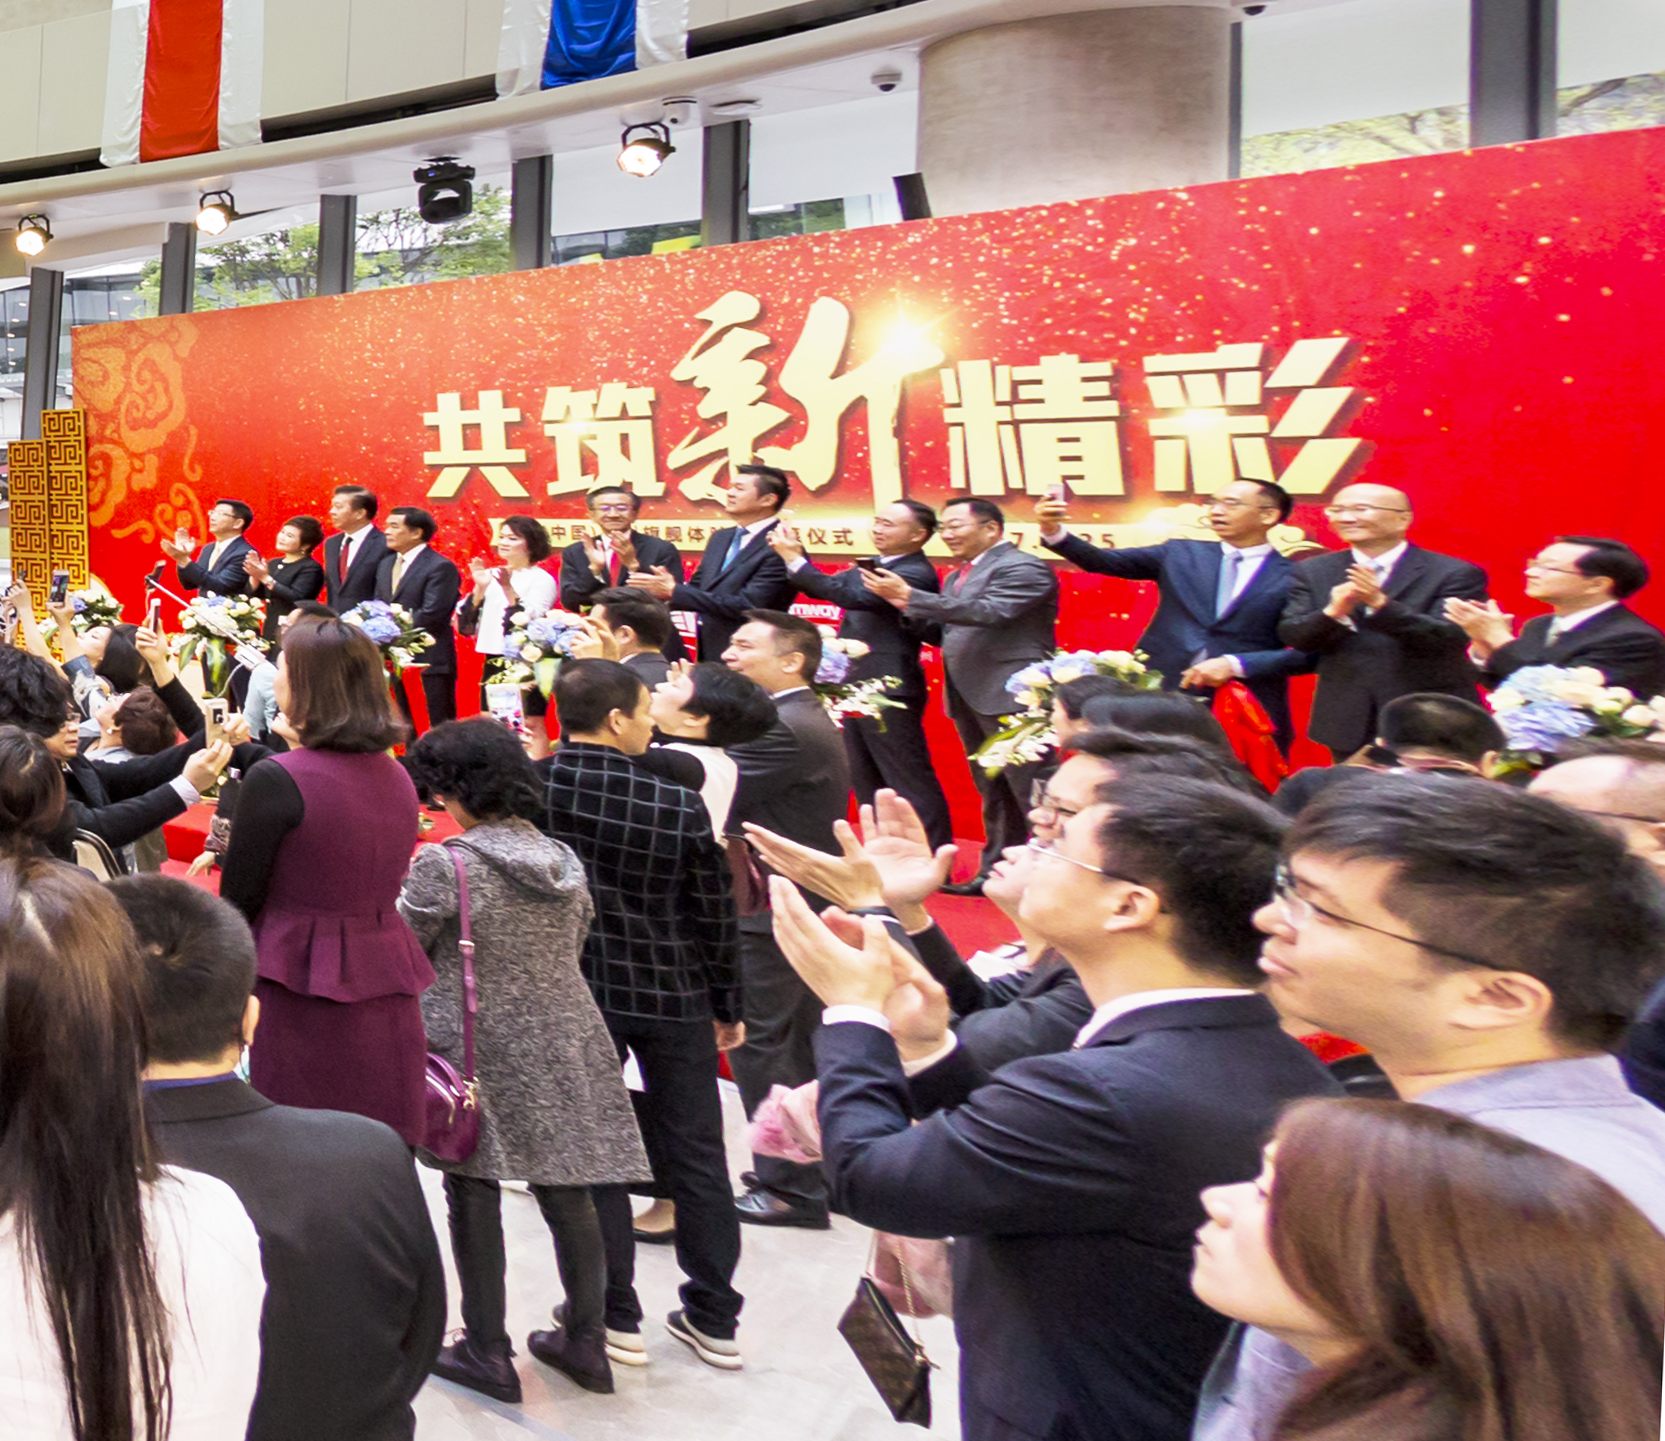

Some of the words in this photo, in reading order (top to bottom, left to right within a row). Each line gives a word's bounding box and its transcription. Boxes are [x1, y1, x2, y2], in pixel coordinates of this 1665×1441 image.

[423, 290, 1362, 515] 共筑新精彩
[788, 602, 841, 621] mway
